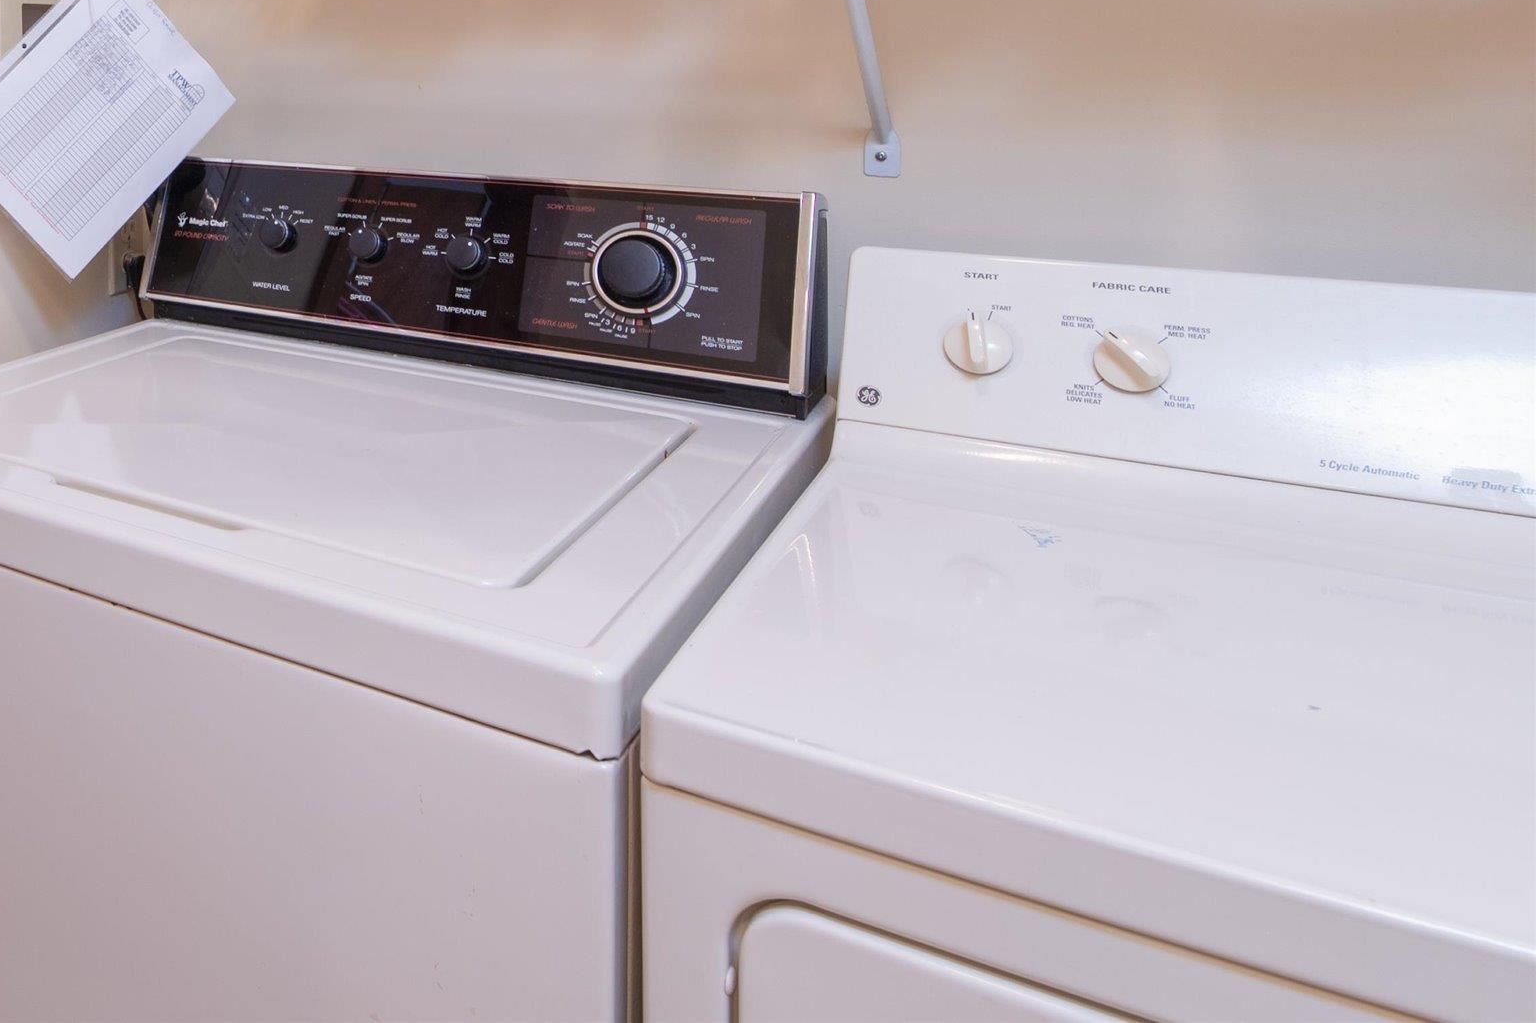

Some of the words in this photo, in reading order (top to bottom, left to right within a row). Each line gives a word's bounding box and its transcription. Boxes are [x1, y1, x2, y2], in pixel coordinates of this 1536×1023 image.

[189, 217, 209, 227] Magic
[210, 218, 226, 228] Chef
[964, 271, 999, 281] START
[252, 281, 272, 290] WATER
[272, 283, 290, 292] LEVEL
[700, 285, 719, 293] RINSE
[1092, 281, 1136, 293] FABRIC
[1138, 284, 1172, 295] CARE
[350, 294, 372, 302] SPEED
[436, 304, 487, 317] TEMPERATURE
[1062, 315, 1094, 323] COTTONS
[1077, 322, 1095, 330] HEAT
[1187, 326, 1211, 335] PRESS
[702, 335, 717, 343] PULL
[1187, 333, 1206, 341] HEAT
[1074, 384, 1095, 392] KNITS
[1066, 390, 1103, 399] DELICATES
[1169, 395, 1190, 403] FLUFF
[1066, 396, 1081, 404] LOW
[1082, 397, 1102, 405] HEAT
[1175, 402, 1195, 410] HEAT
[1319, 459, 1326, 468] 5
[1328, 460, 1359, 472] Cycle
[1362, 465, 1421, 480] Automatic
[1442, 475, 1479, 489] Heavy
[1481, 480, 1509, 493] Duty
[1511, 484, 1536, 496] Extr
